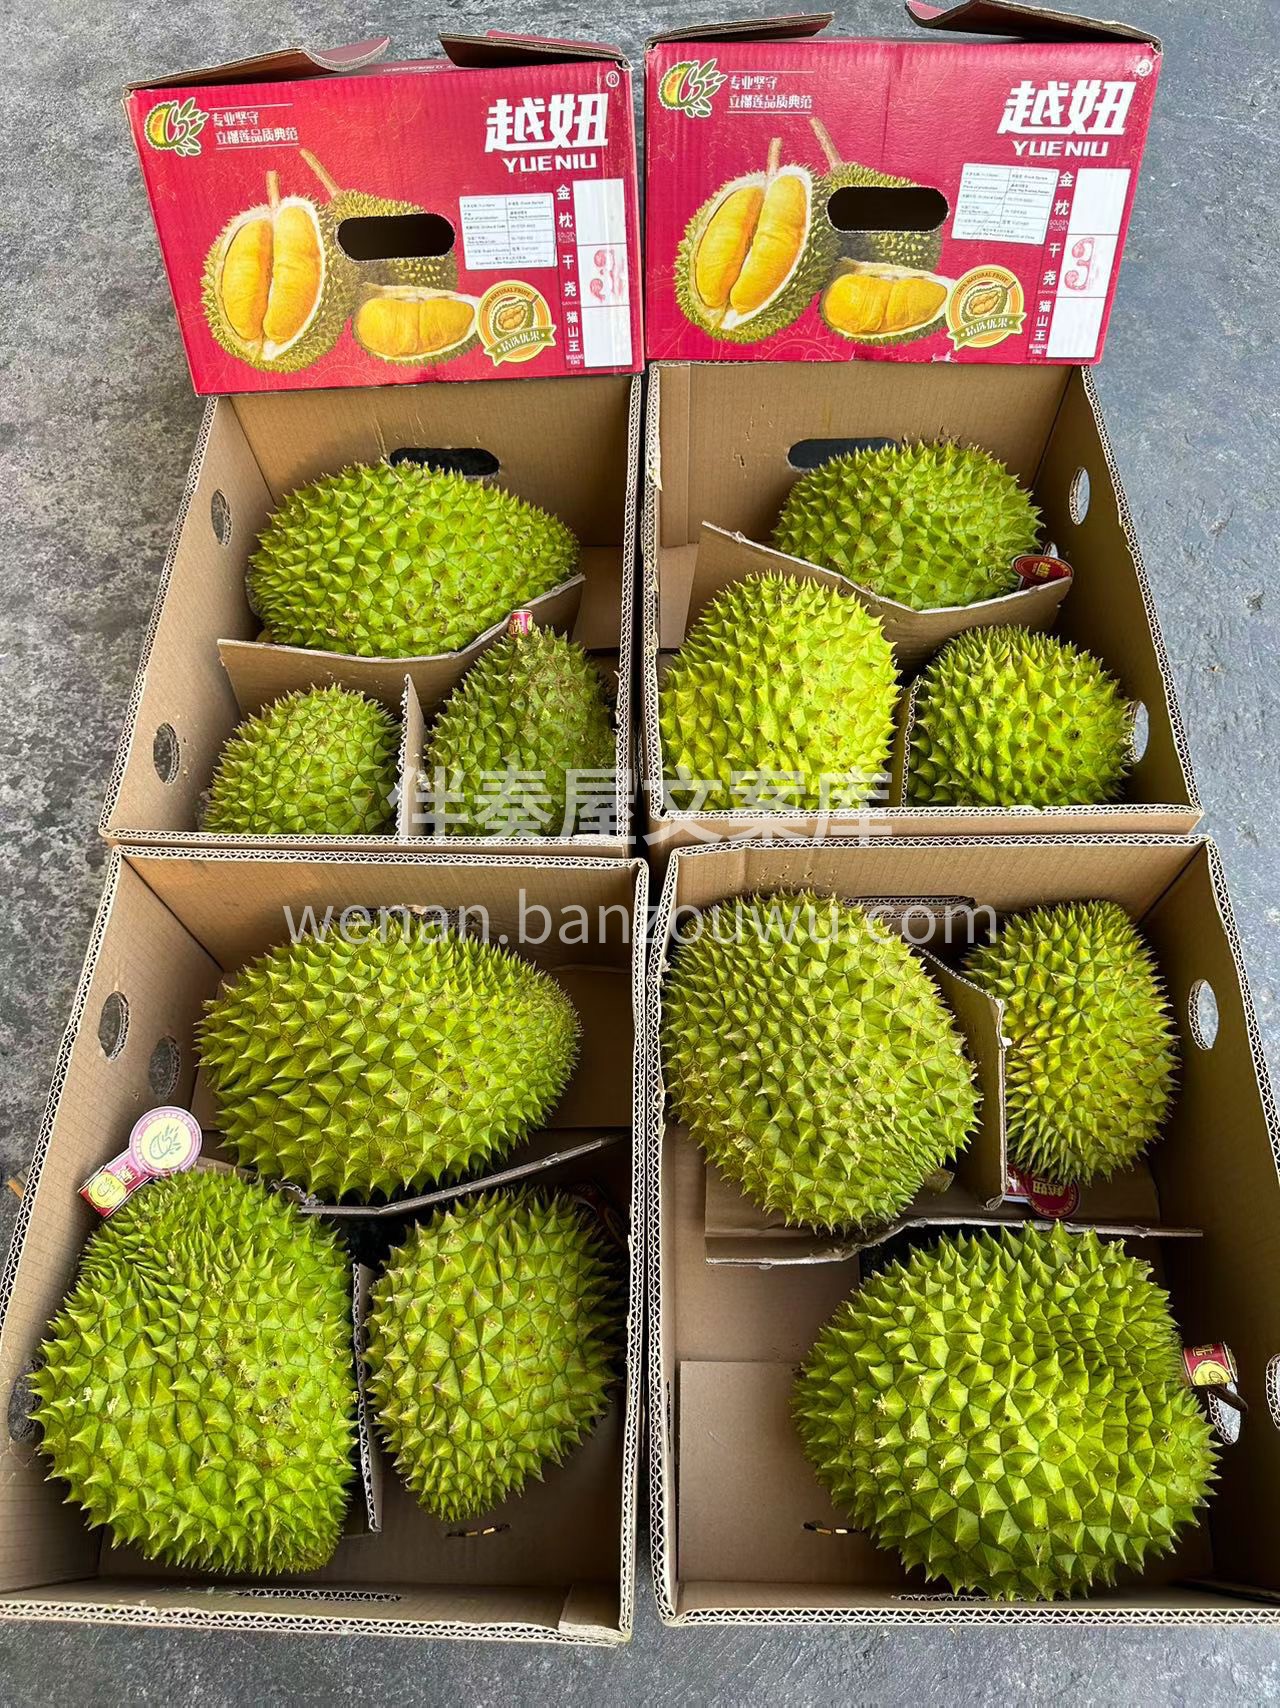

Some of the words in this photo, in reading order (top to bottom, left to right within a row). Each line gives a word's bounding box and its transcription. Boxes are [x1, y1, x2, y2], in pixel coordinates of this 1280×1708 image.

[729, 75, 778, 91] 专业坚守
[211, 110, 259, 127] 专业坚守
[484, 92, 609, 153] 越妞
[996, 79, 1136, 136] 越妞
[555, 183, 573, 229] 金枕
[1053, 171, 1075, 217] 金枕
[566, 311, 581, 353] 猫山王
[1034, 300, 1052, 342] 猫山王
